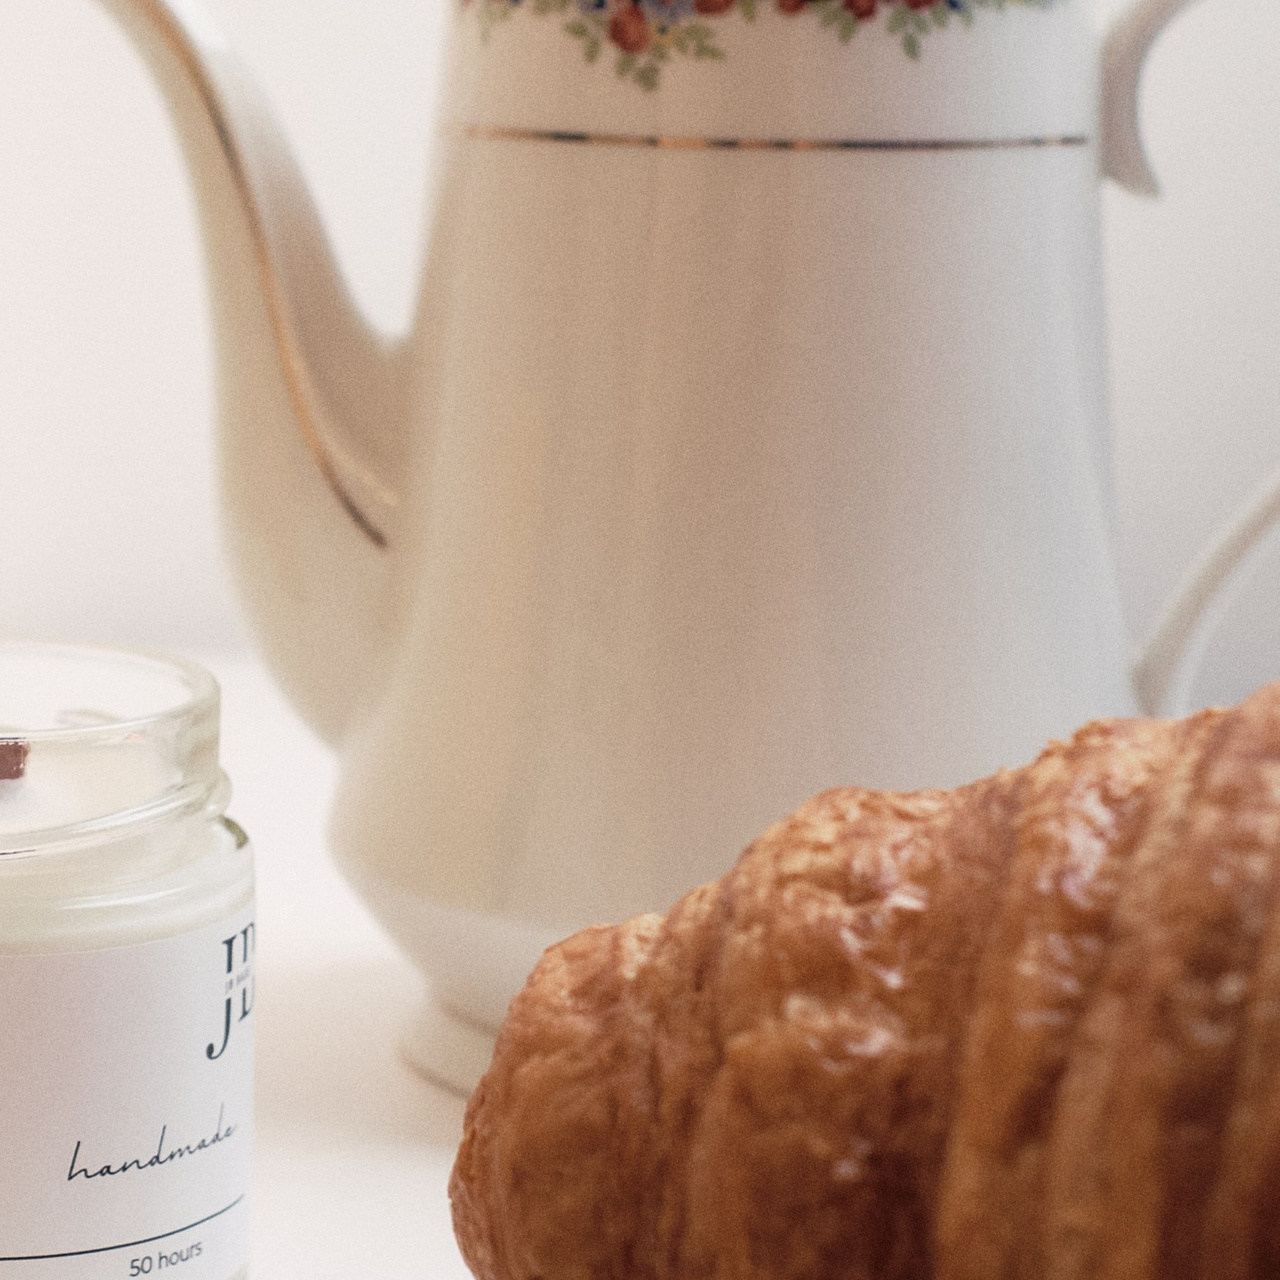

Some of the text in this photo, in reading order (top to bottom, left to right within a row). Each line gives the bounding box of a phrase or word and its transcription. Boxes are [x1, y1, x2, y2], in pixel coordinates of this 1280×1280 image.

[67, 1102, 237, 1181] handmade
[129, 1242, 203, 1277] 50 hours
